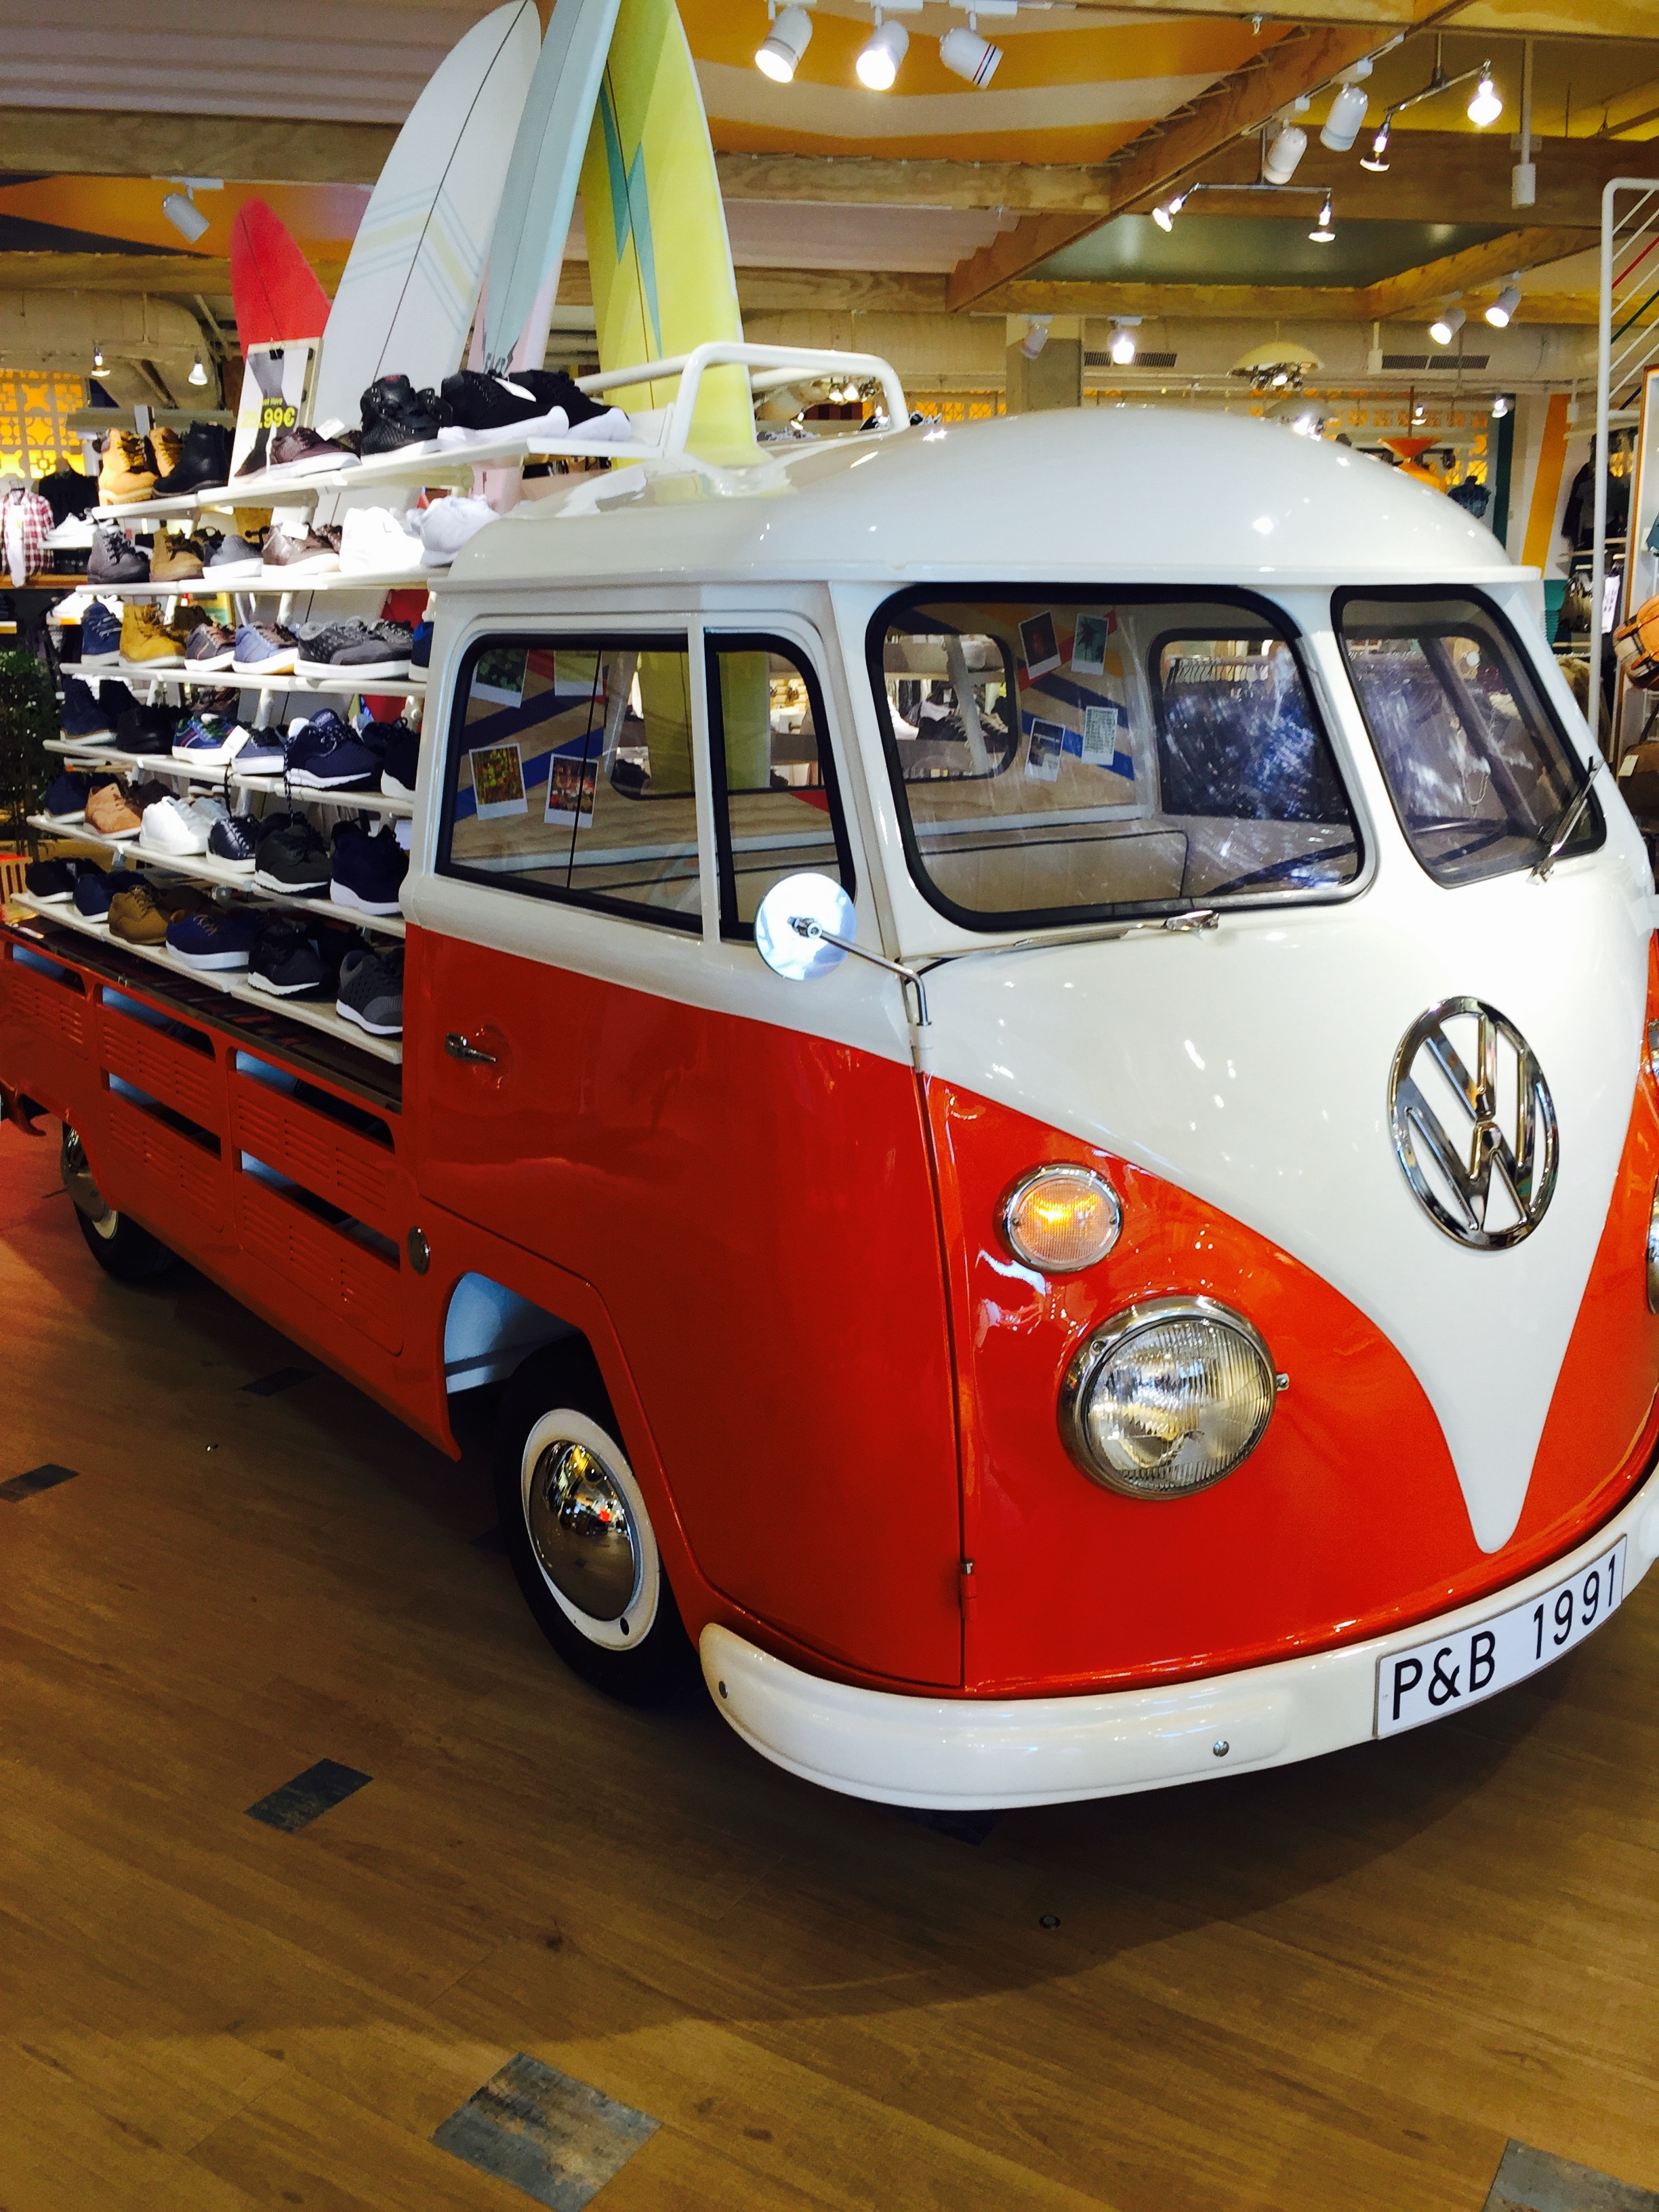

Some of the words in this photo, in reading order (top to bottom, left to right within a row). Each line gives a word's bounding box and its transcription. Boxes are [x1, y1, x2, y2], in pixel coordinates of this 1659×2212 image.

[1391, 1000, 1556, 1247] VW
[1393, 1631, 1496, 1721] P&B
[1534, 1553, 1616, 1660] 1991
